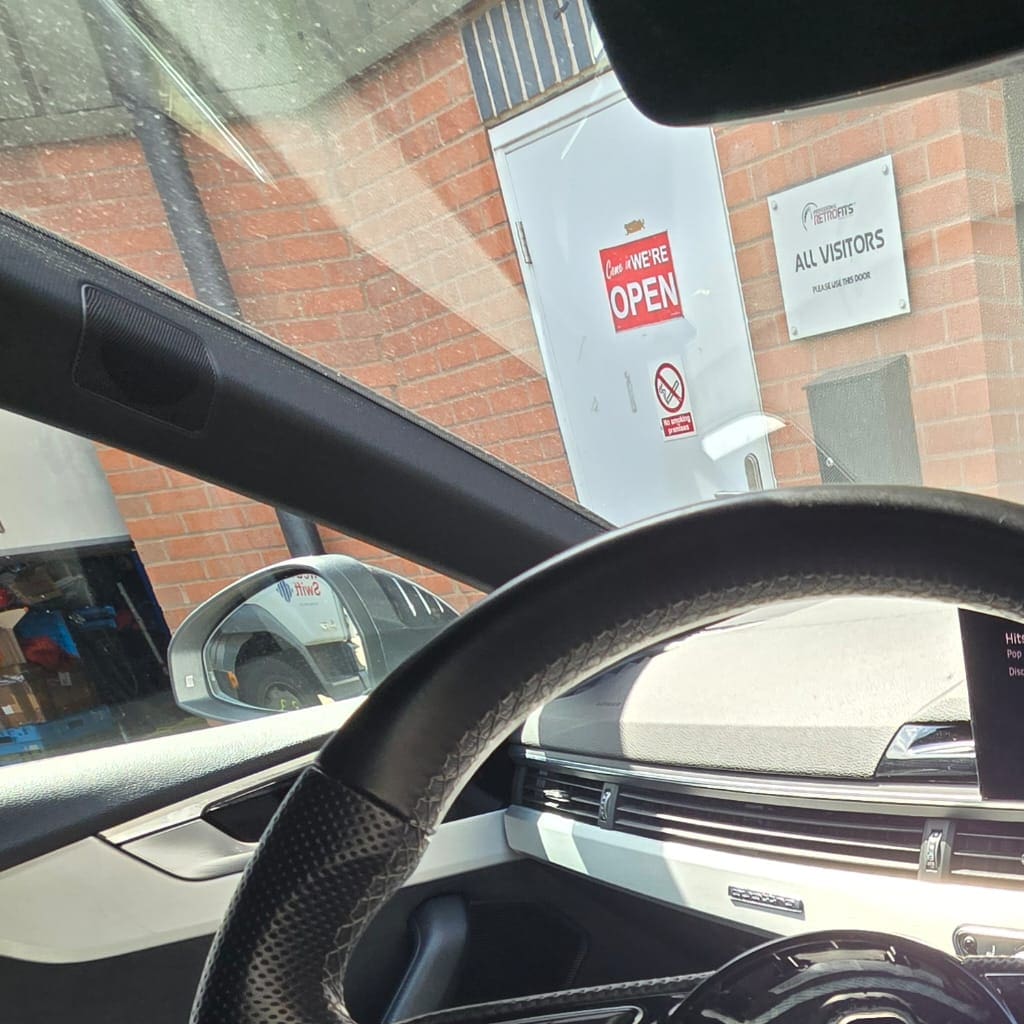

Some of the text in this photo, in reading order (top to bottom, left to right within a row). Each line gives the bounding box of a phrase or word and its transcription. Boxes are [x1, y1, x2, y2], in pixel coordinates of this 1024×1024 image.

[605, 259, 624, 280] Come
[630, 244, 669, 271] WE'RE
[795, 228, 885, 272] ALL VISITORS
[610, 271, 679, 319] OPEN
[812, 271, 871, 294] PLEASE USE THIS DOOR
[1007, 649, 1022, 660] Pop
